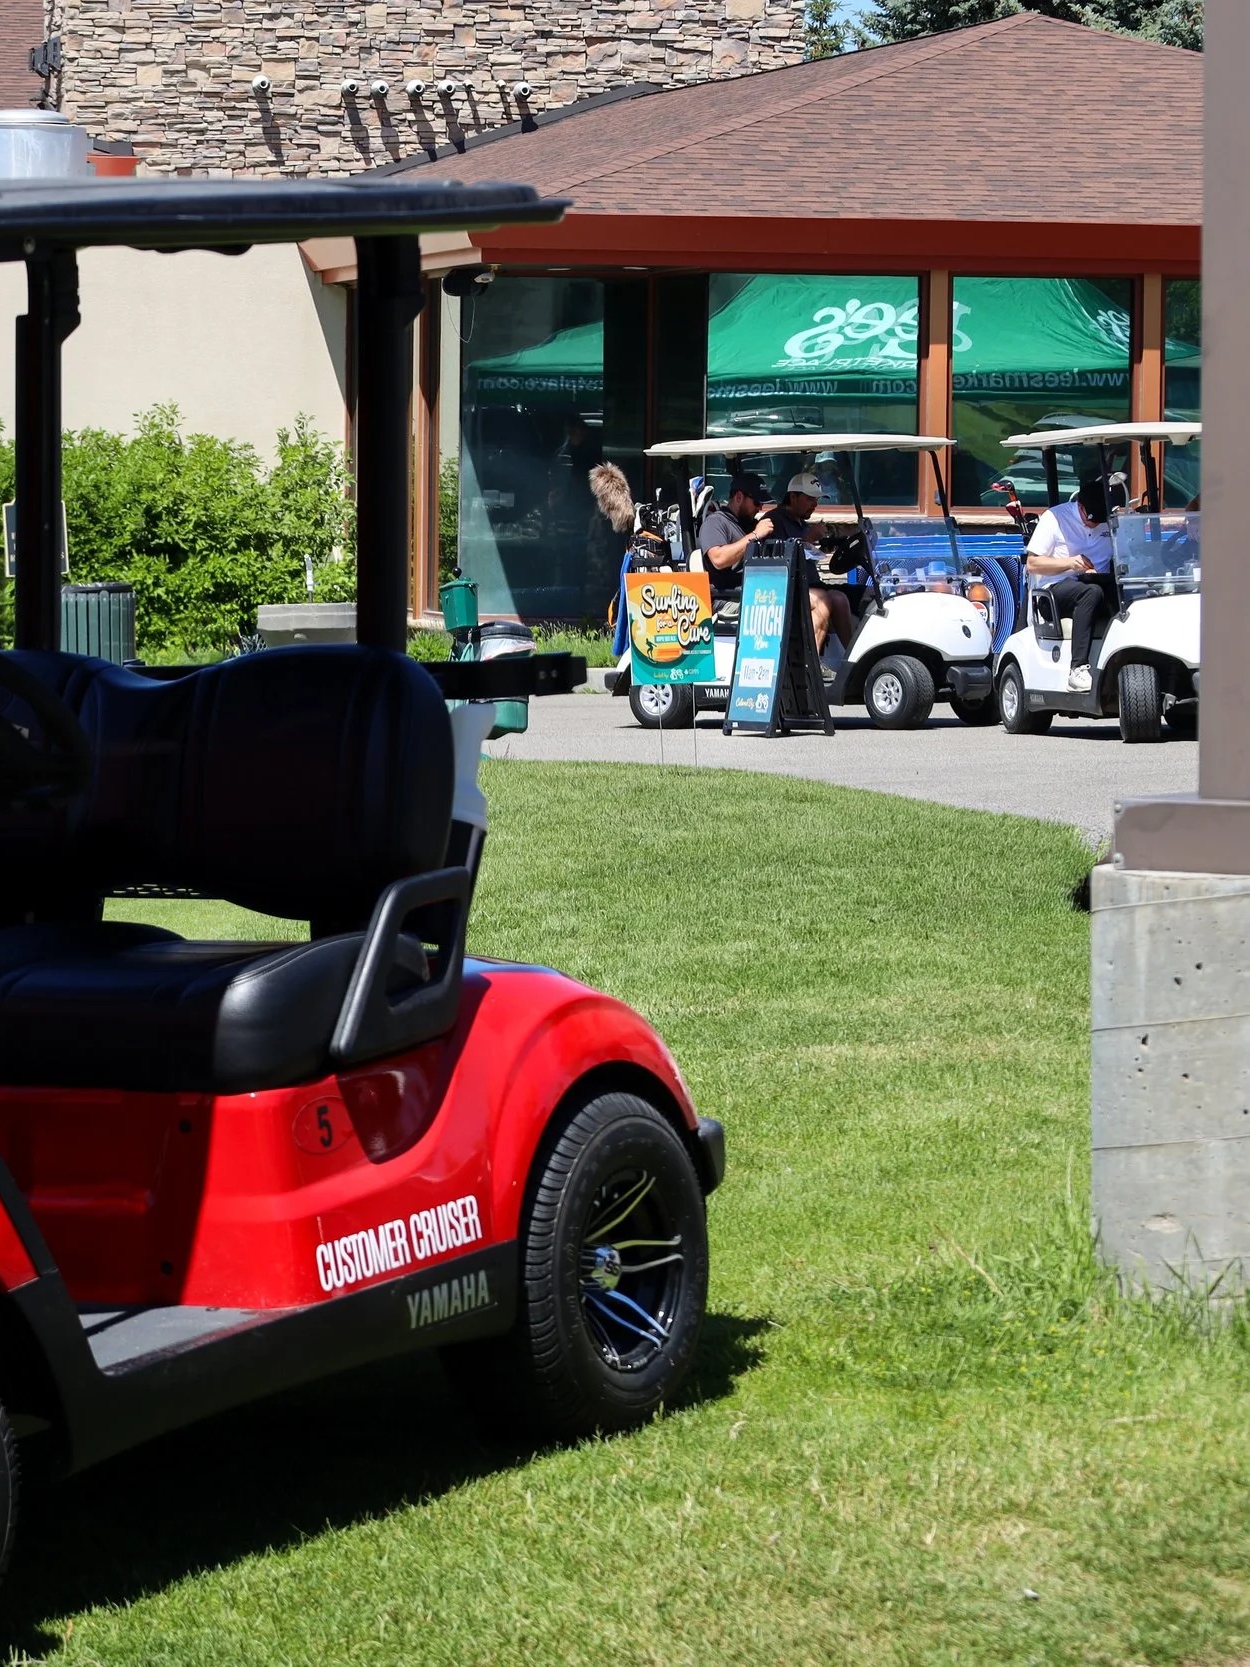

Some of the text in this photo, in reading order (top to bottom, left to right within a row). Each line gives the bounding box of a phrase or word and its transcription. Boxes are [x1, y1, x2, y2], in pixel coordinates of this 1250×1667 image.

[641, 584, 699, 624] Surfing
[743, 605, 783, 636] LUNCH
[677, 614, 711, 649] Cure
[704, 688, 730, 698] YAMAH
[315, 1104, 333, 1148] 5
[315, 1195, 483, 1292] CUSTOMER CRUISER
[406, 1269, 490, 1330] YAMAHA
